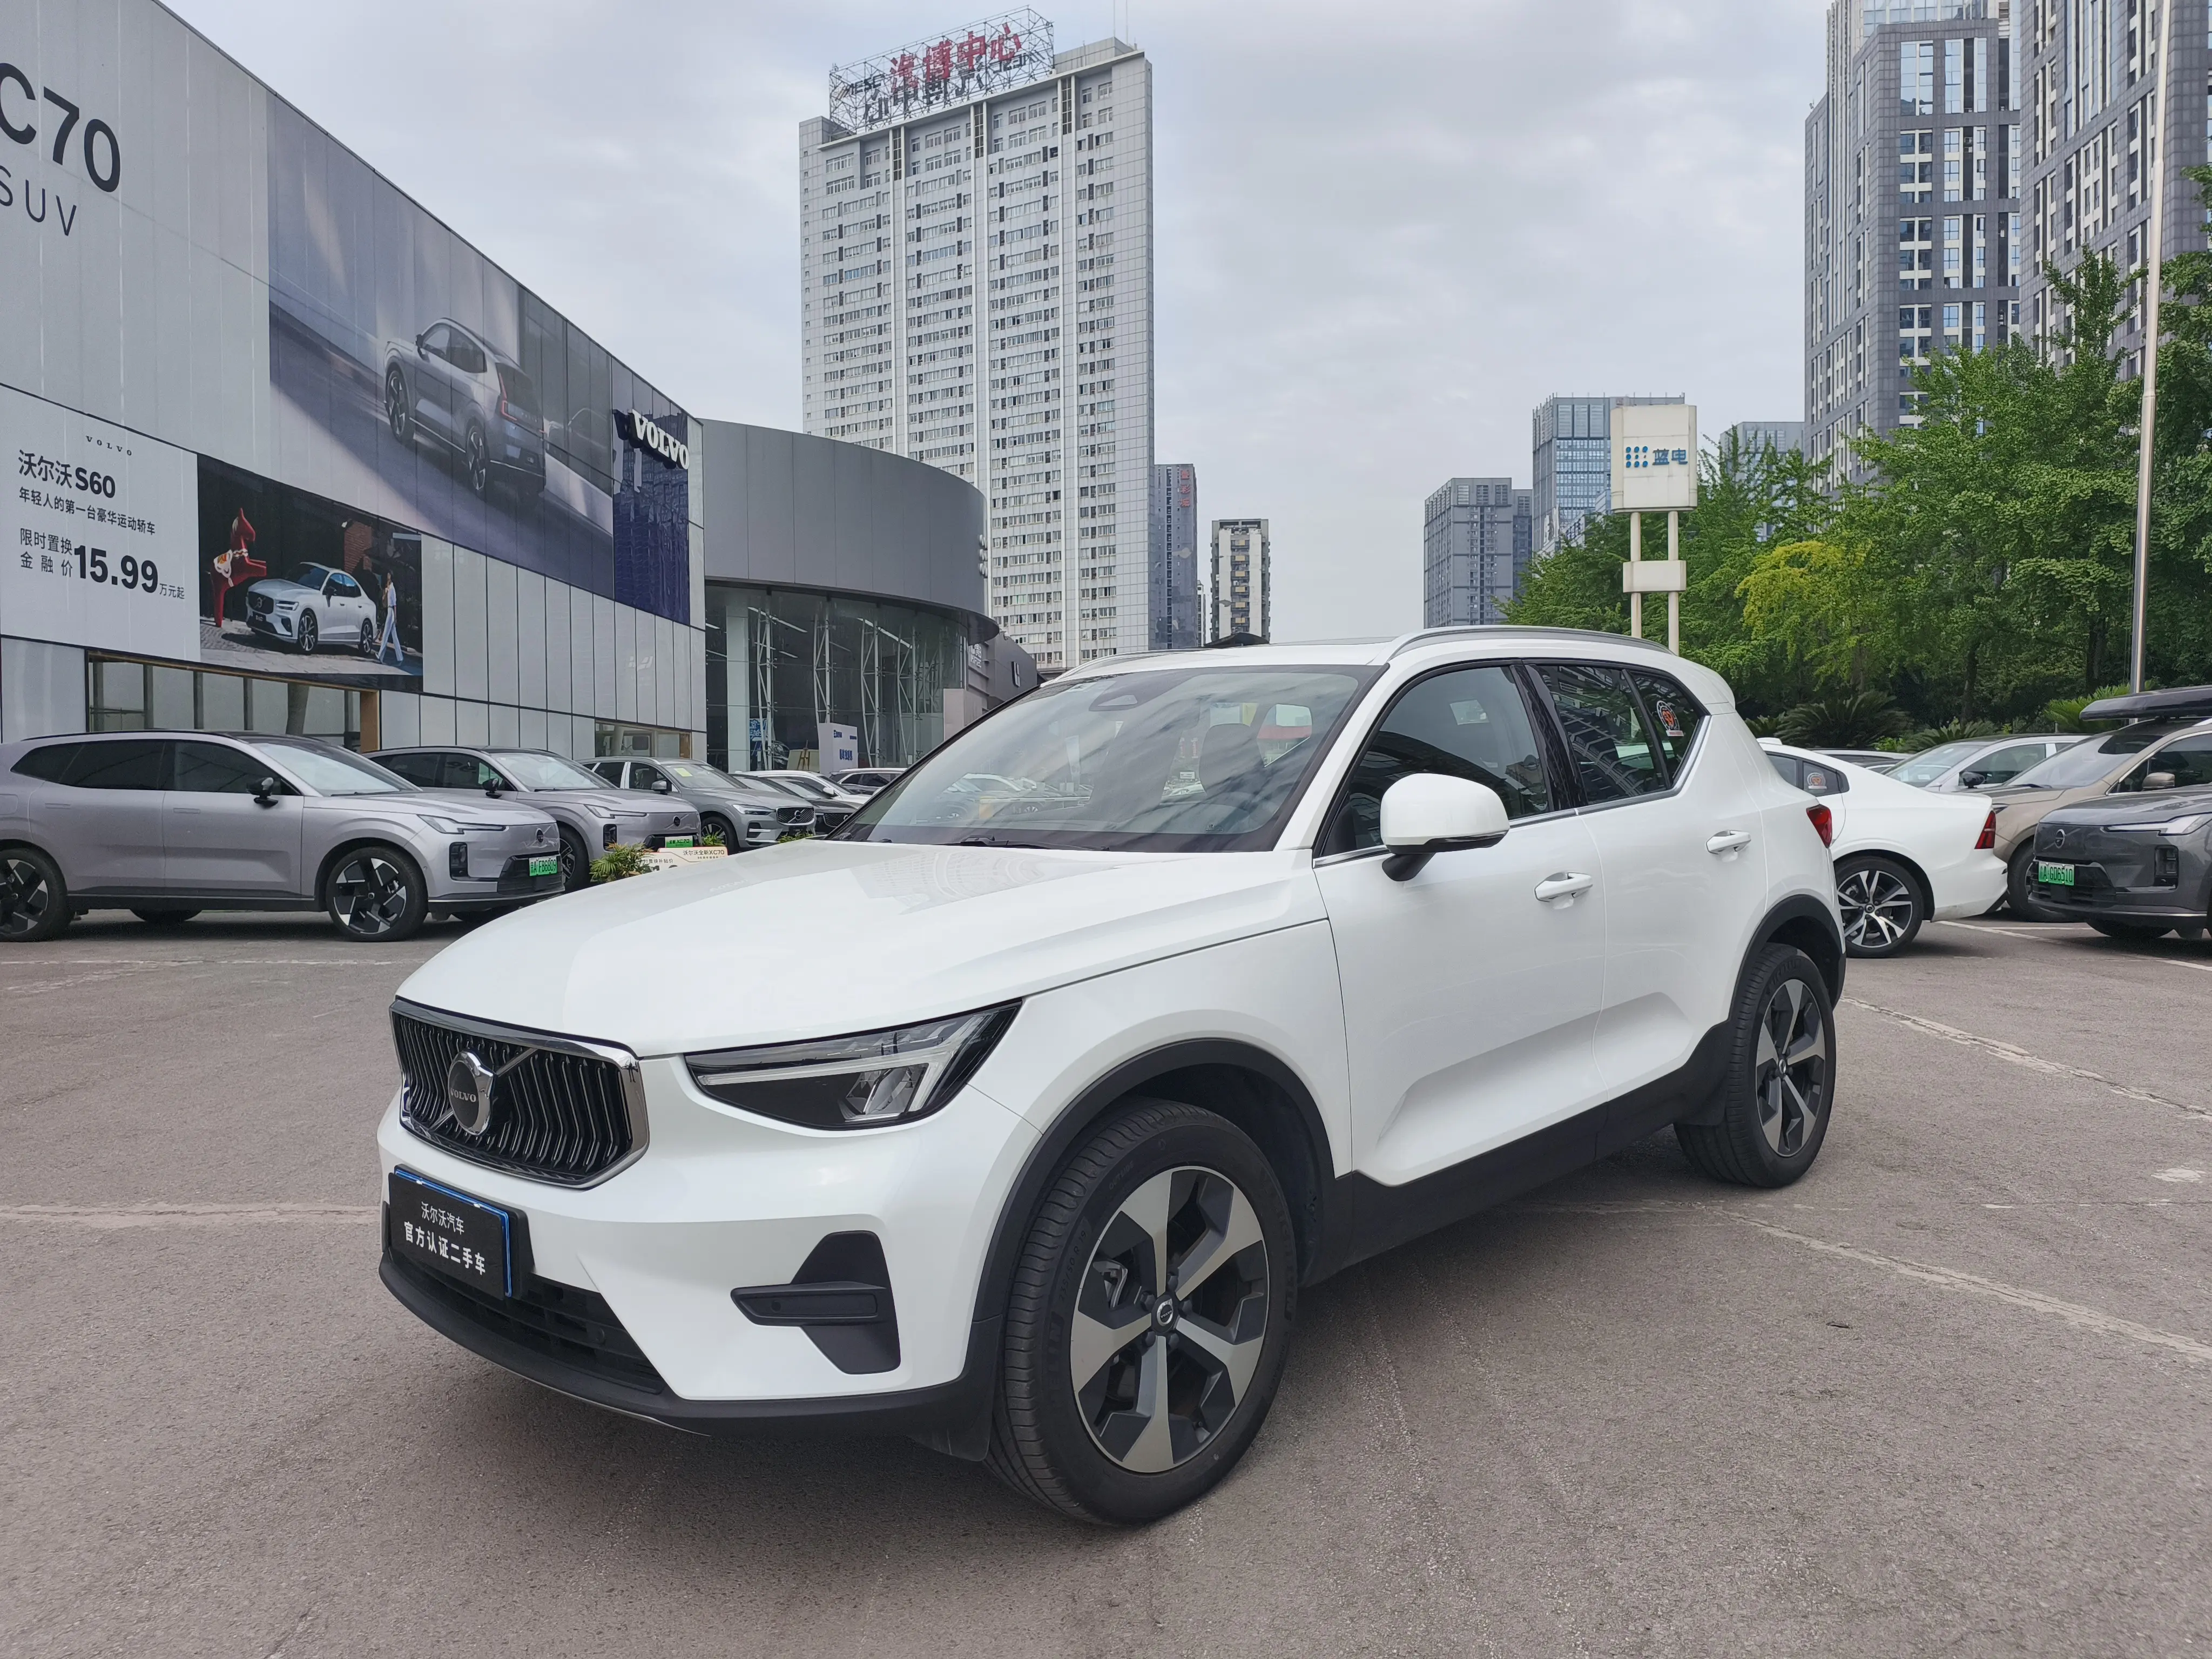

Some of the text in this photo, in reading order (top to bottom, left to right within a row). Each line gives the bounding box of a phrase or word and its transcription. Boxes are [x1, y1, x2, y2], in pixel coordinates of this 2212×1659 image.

[0, 63, 120, 192] C70
[86, 435, 132, 456] VOLVO
[632, 409, 690, 469] VOLVO
[1653, 448, 1688, 466] 蓝电
[19, 487, 156, 535] 年轻人的第一台豪华运动轿车
[20, 528, 72, 556] 限时置换
[74, 545, 185, 599] 15.99 万元起
[450, 1088, 476, 1102] VOLVO
[421, 1201, 464, 1235] 沃尔沃汽车
[404, 1221, 485, 1275] 官方认证二手车
